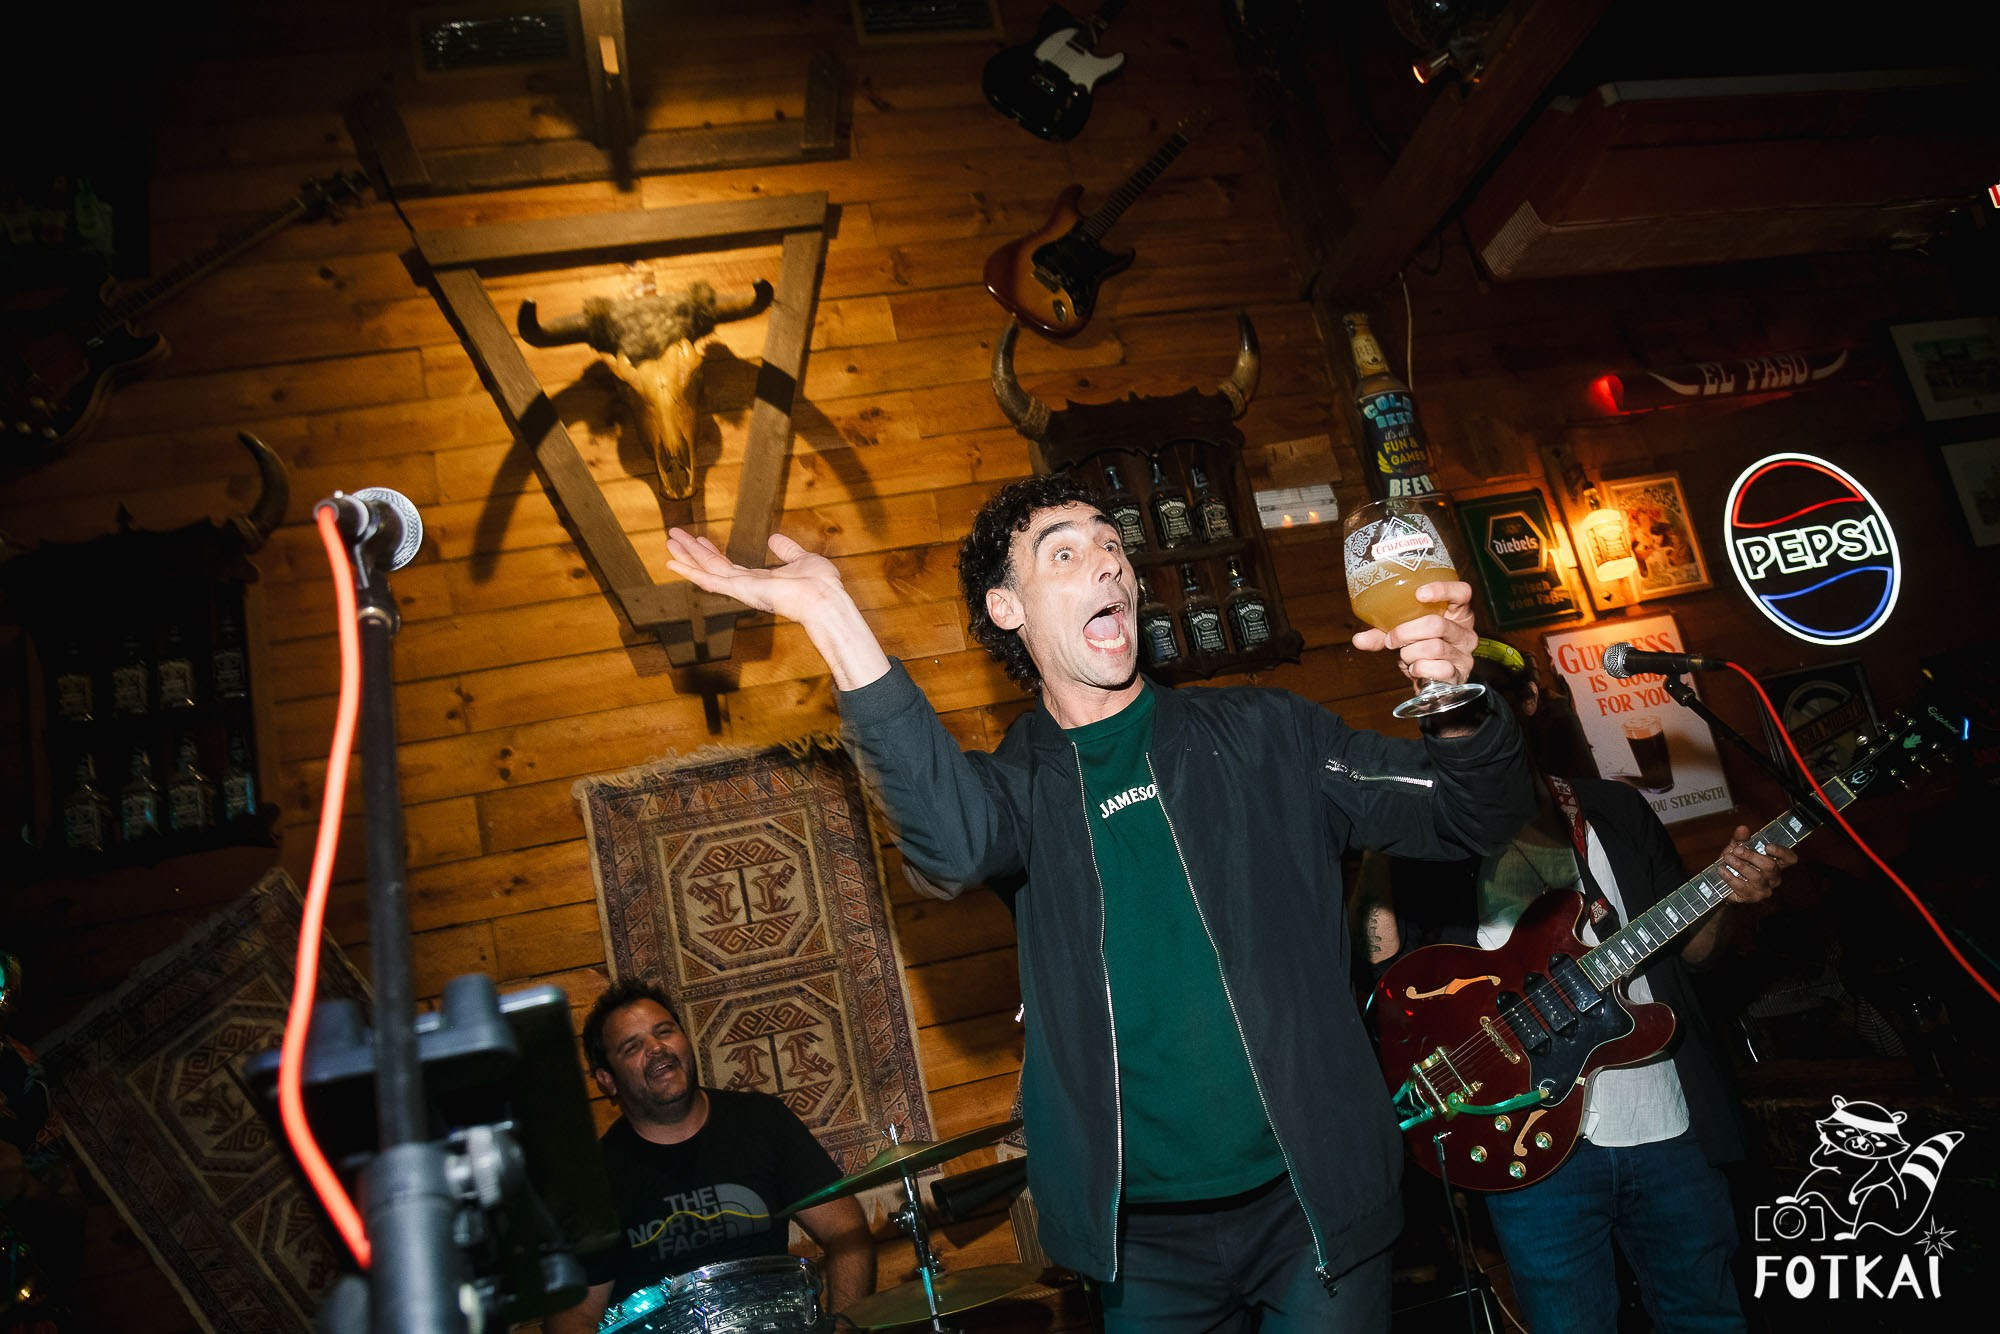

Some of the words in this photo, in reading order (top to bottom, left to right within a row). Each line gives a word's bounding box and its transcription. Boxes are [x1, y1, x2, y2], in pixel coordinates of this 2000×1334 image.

[1699, 362, 1735, 396] EL
[1744, 353, 1808, 391] PASO
[1383, 438, 1409, 454] FUN
[1409, 436, 1419, 449] &
[1389, 473, 1435, 497] BEER
[1376, 536, 1430, 555] Cruzcampo
[1492, 535, 1540, 555] Diebels
[1736, 514, 1889, 580] PEPSI
[1557, 632, 1676, 675] GUIESS
[1589, 673, 1608, 694] IS
[1597, 694, 1635, 717] FOR
[1633, 686, 1671, 708] YOU
[1650, 799, 1668, 813] OU
[1670, 786, 1725, 809] STRENGTH
[663, 1186, 718, 1213] THE
[657, 1224, 725, 1261] FACE
